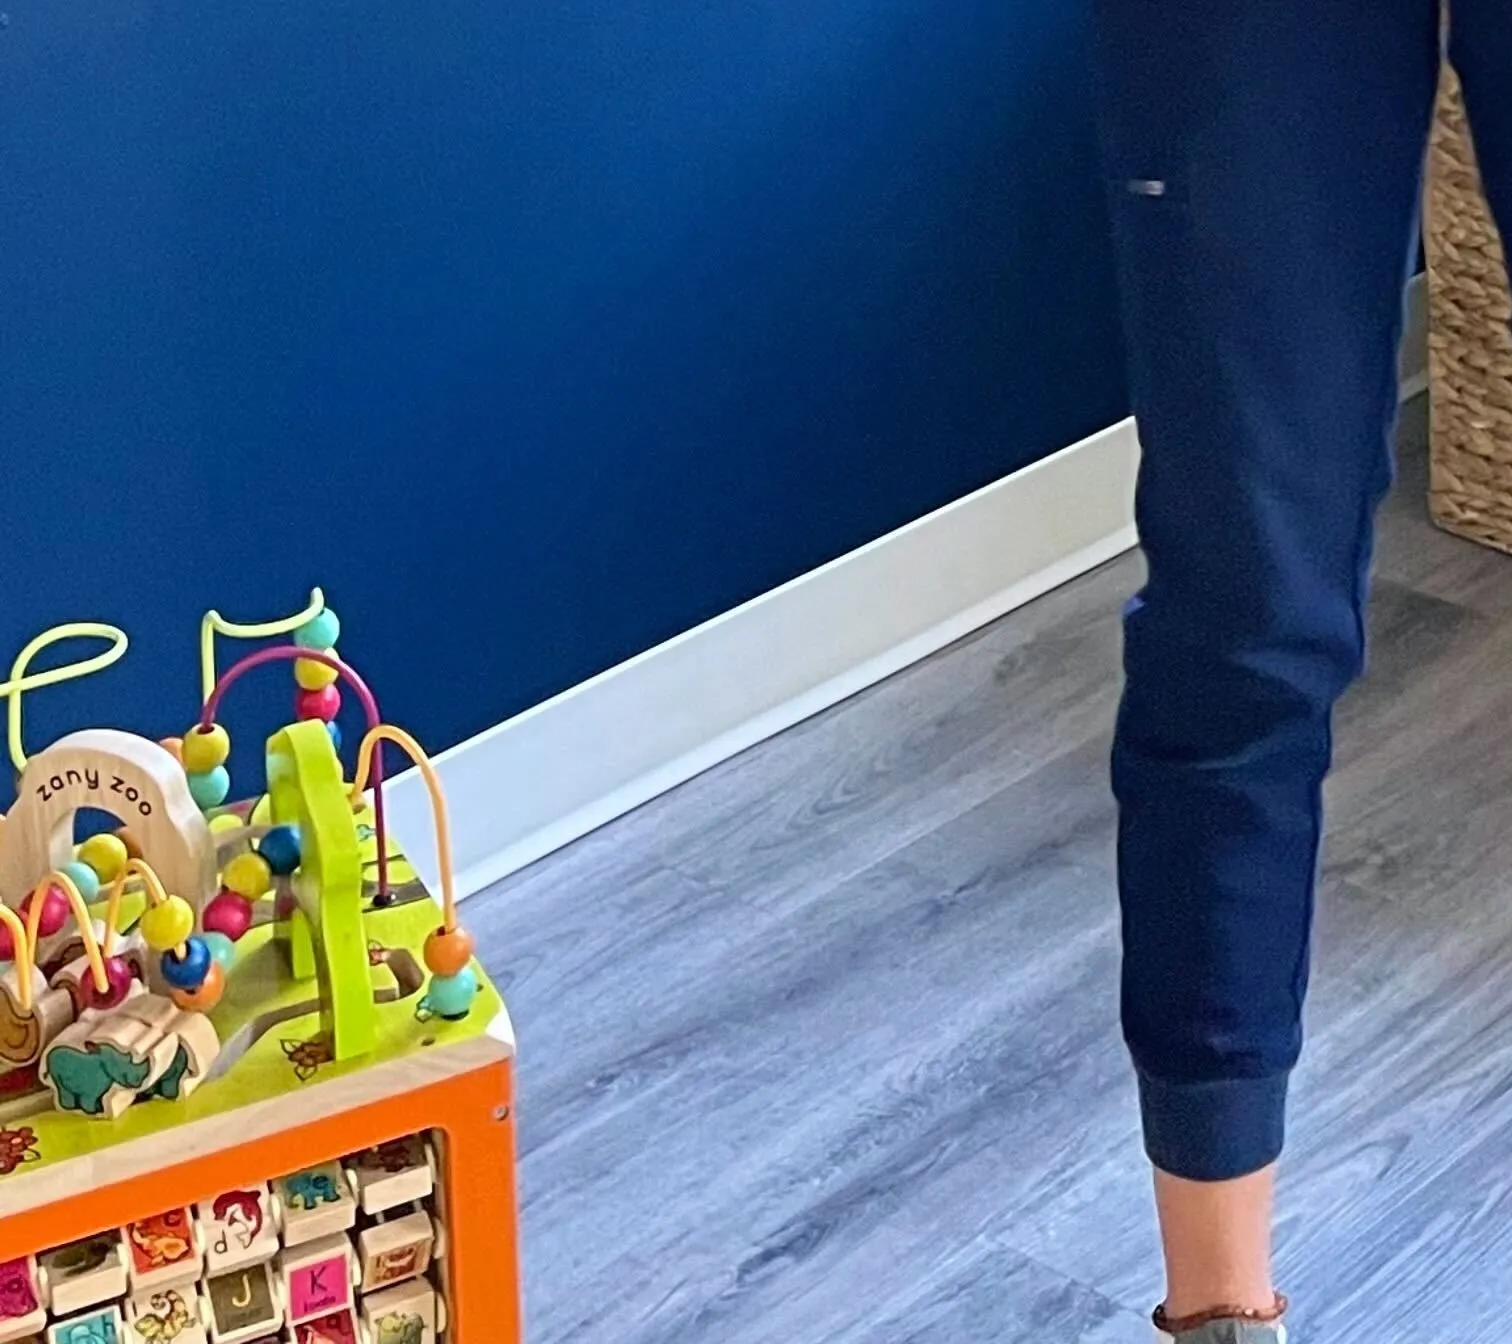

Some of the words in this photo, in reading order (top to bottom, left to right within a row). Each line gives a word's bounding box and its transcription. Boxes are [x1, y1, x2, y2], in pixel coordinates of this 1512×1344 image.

[36, 768, 99, 802] zany
[110, 775, 152, 816] zoo
[214, 1228, 228, 1254] d
[232, 1274, 251, 1308] J
[310, 1265, 328, 1296] K
